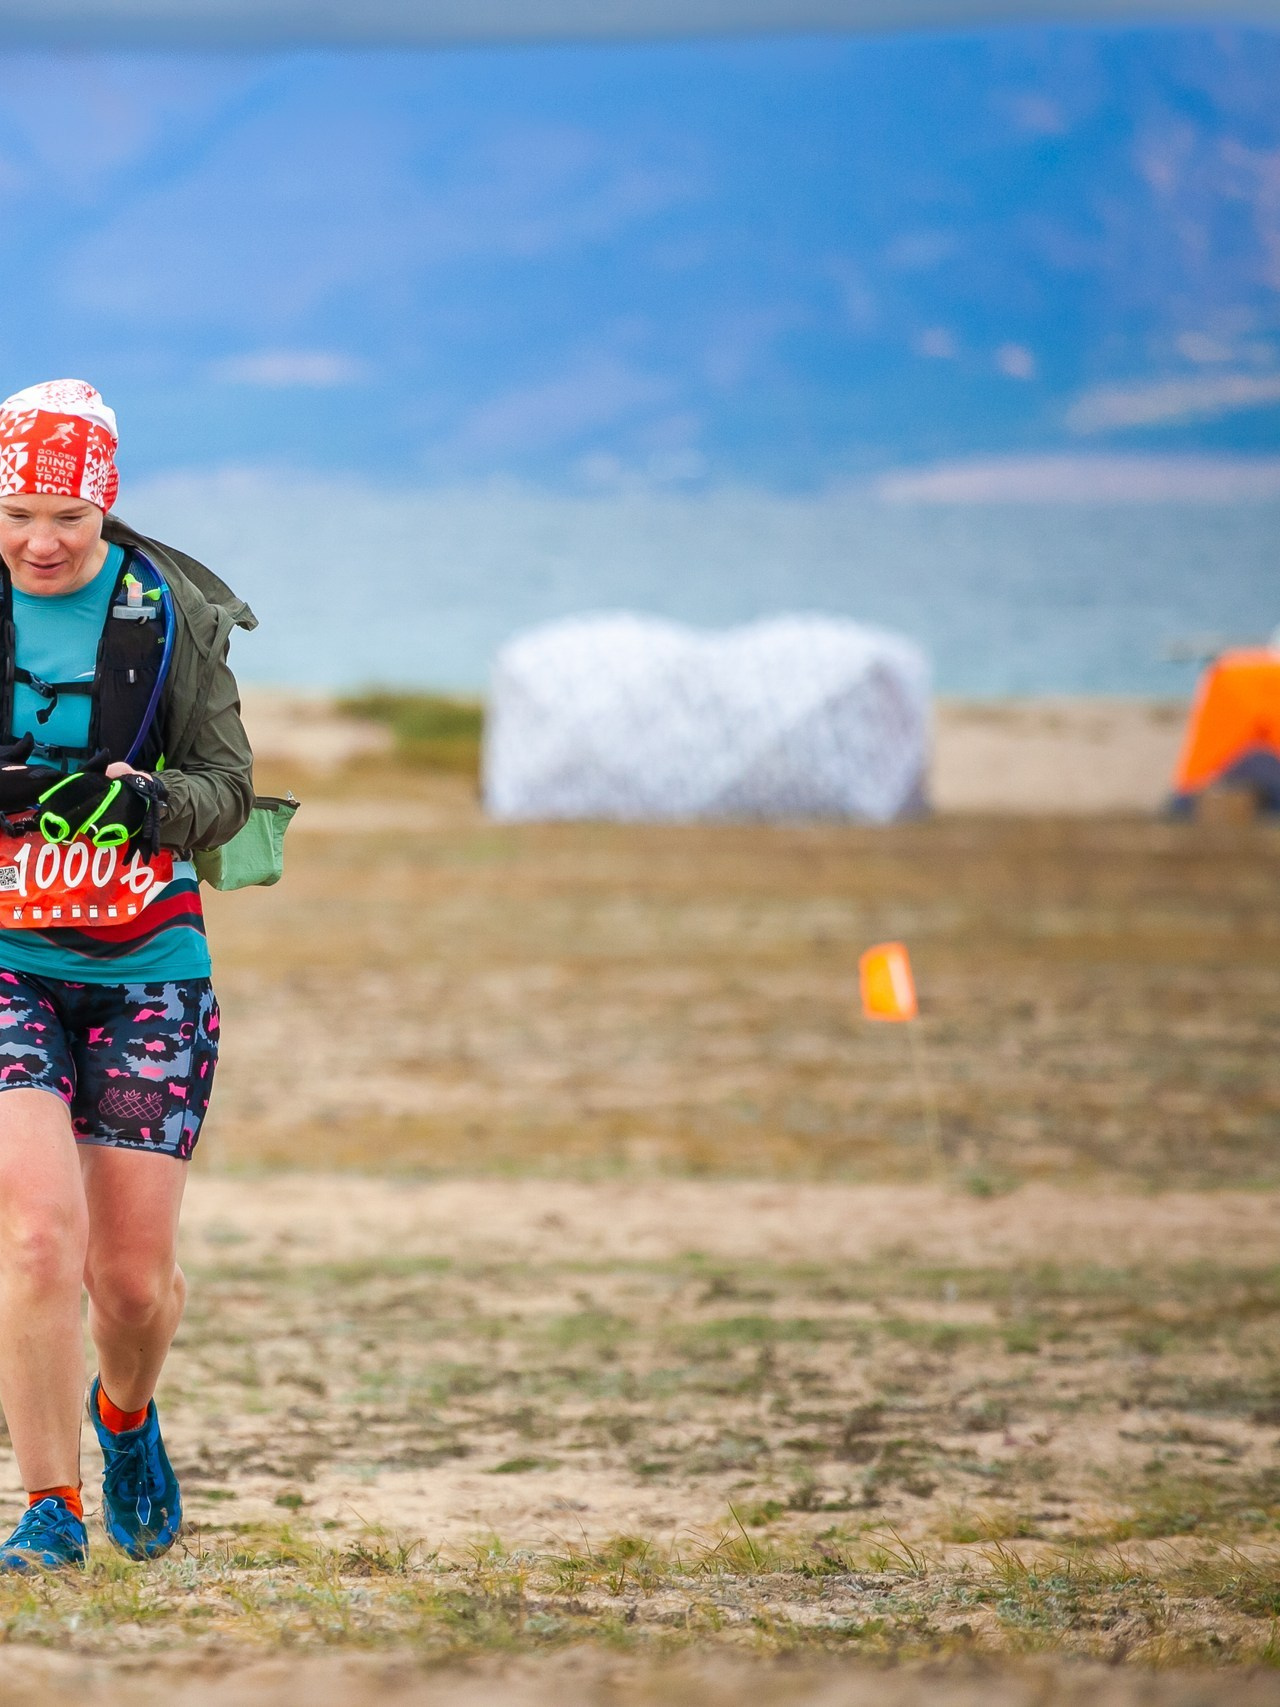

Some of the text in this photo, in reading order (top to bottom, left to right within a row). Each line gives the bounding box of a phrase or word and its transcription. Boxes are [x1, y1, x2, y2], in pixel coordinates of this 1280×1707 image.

[38, 448, 77, 462] GOLDEN
[36, 455, 76, 471] RING
[35, 465, 74, 479] ULTRA
[35, 473, 73, 487] TRAIL
[35, 482, 71, 495] 100
